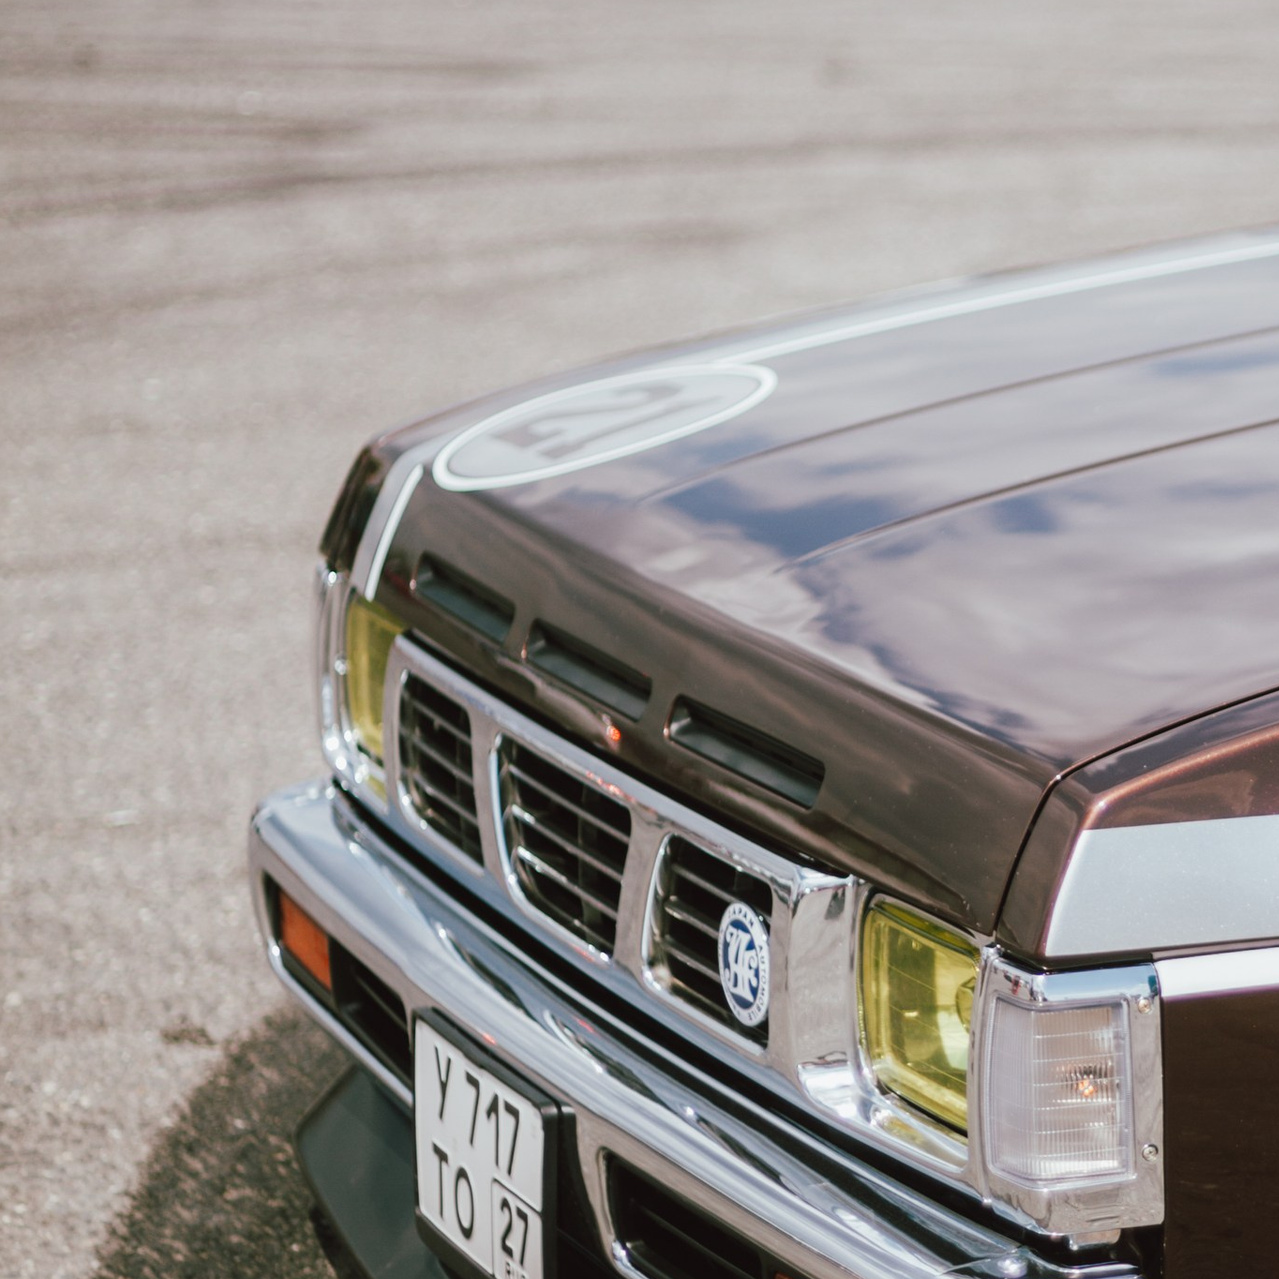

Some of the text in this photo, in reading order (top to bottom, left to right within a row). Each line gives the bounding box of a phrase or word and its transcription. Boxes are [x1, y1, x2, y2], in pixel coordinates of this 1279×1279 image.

[727, 906, 754, 928] JAPAN
[747, 944, 768, 1022] AUTOMOBILE
[500, 1196, 529, 1269] 27
